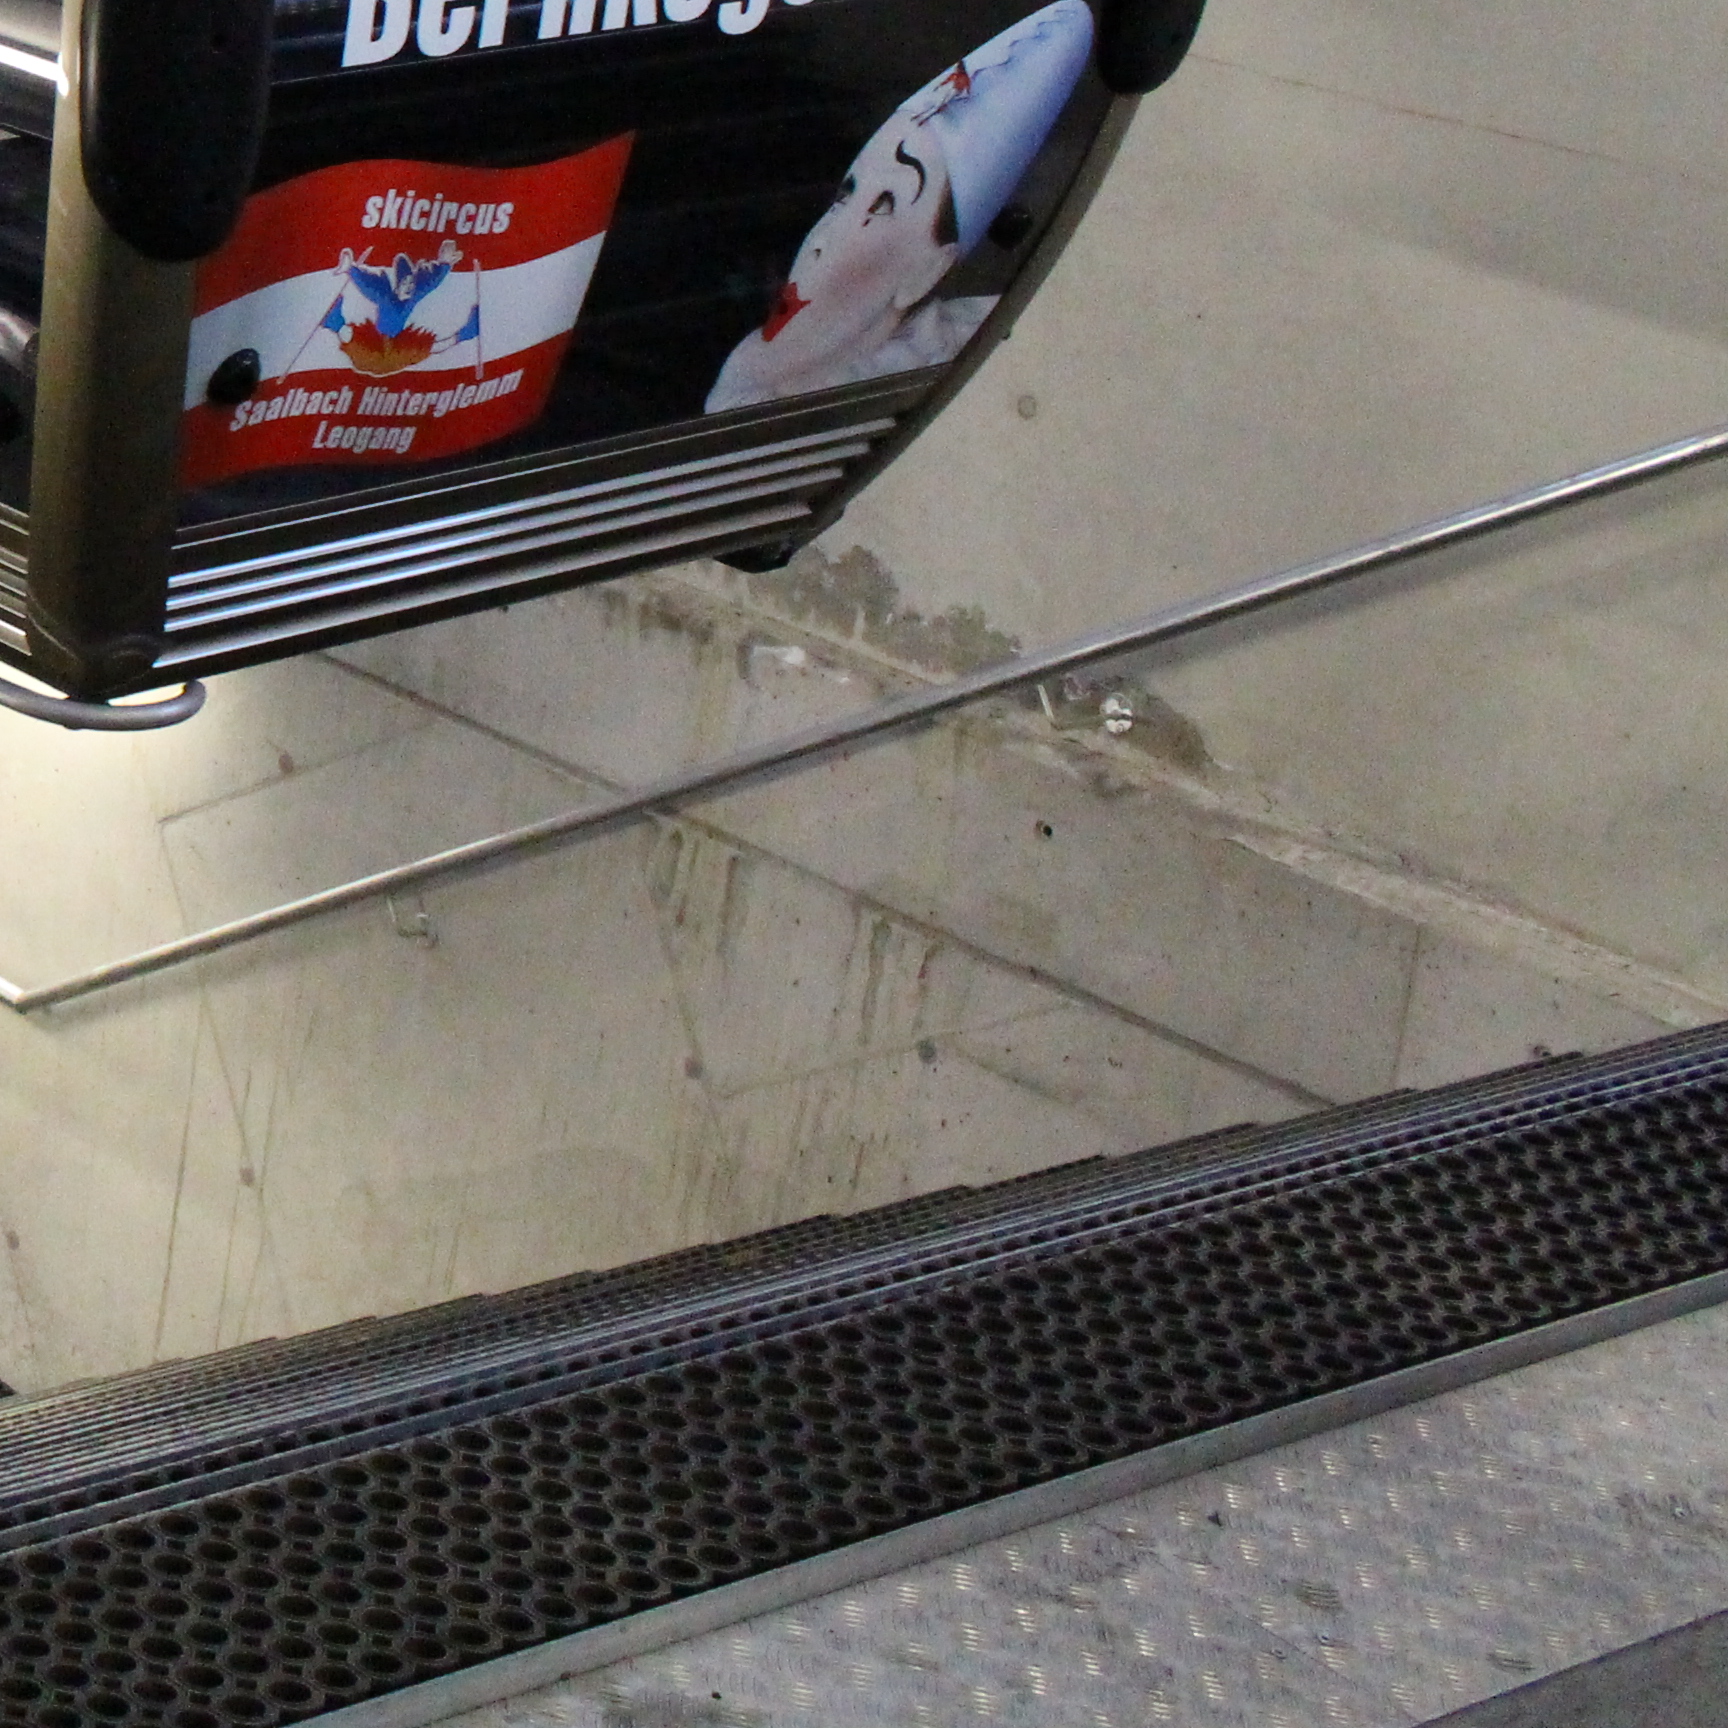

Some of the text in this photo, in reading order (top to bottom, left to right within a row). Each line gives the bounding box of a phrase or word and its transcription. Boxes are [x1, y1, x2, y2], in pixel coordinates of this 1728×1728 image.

[361, 189, 515, 235] skicircus
[229, 368, 525, 432] Saalbach Hinterglemm
[311, 420, 417, 454] Leogang
